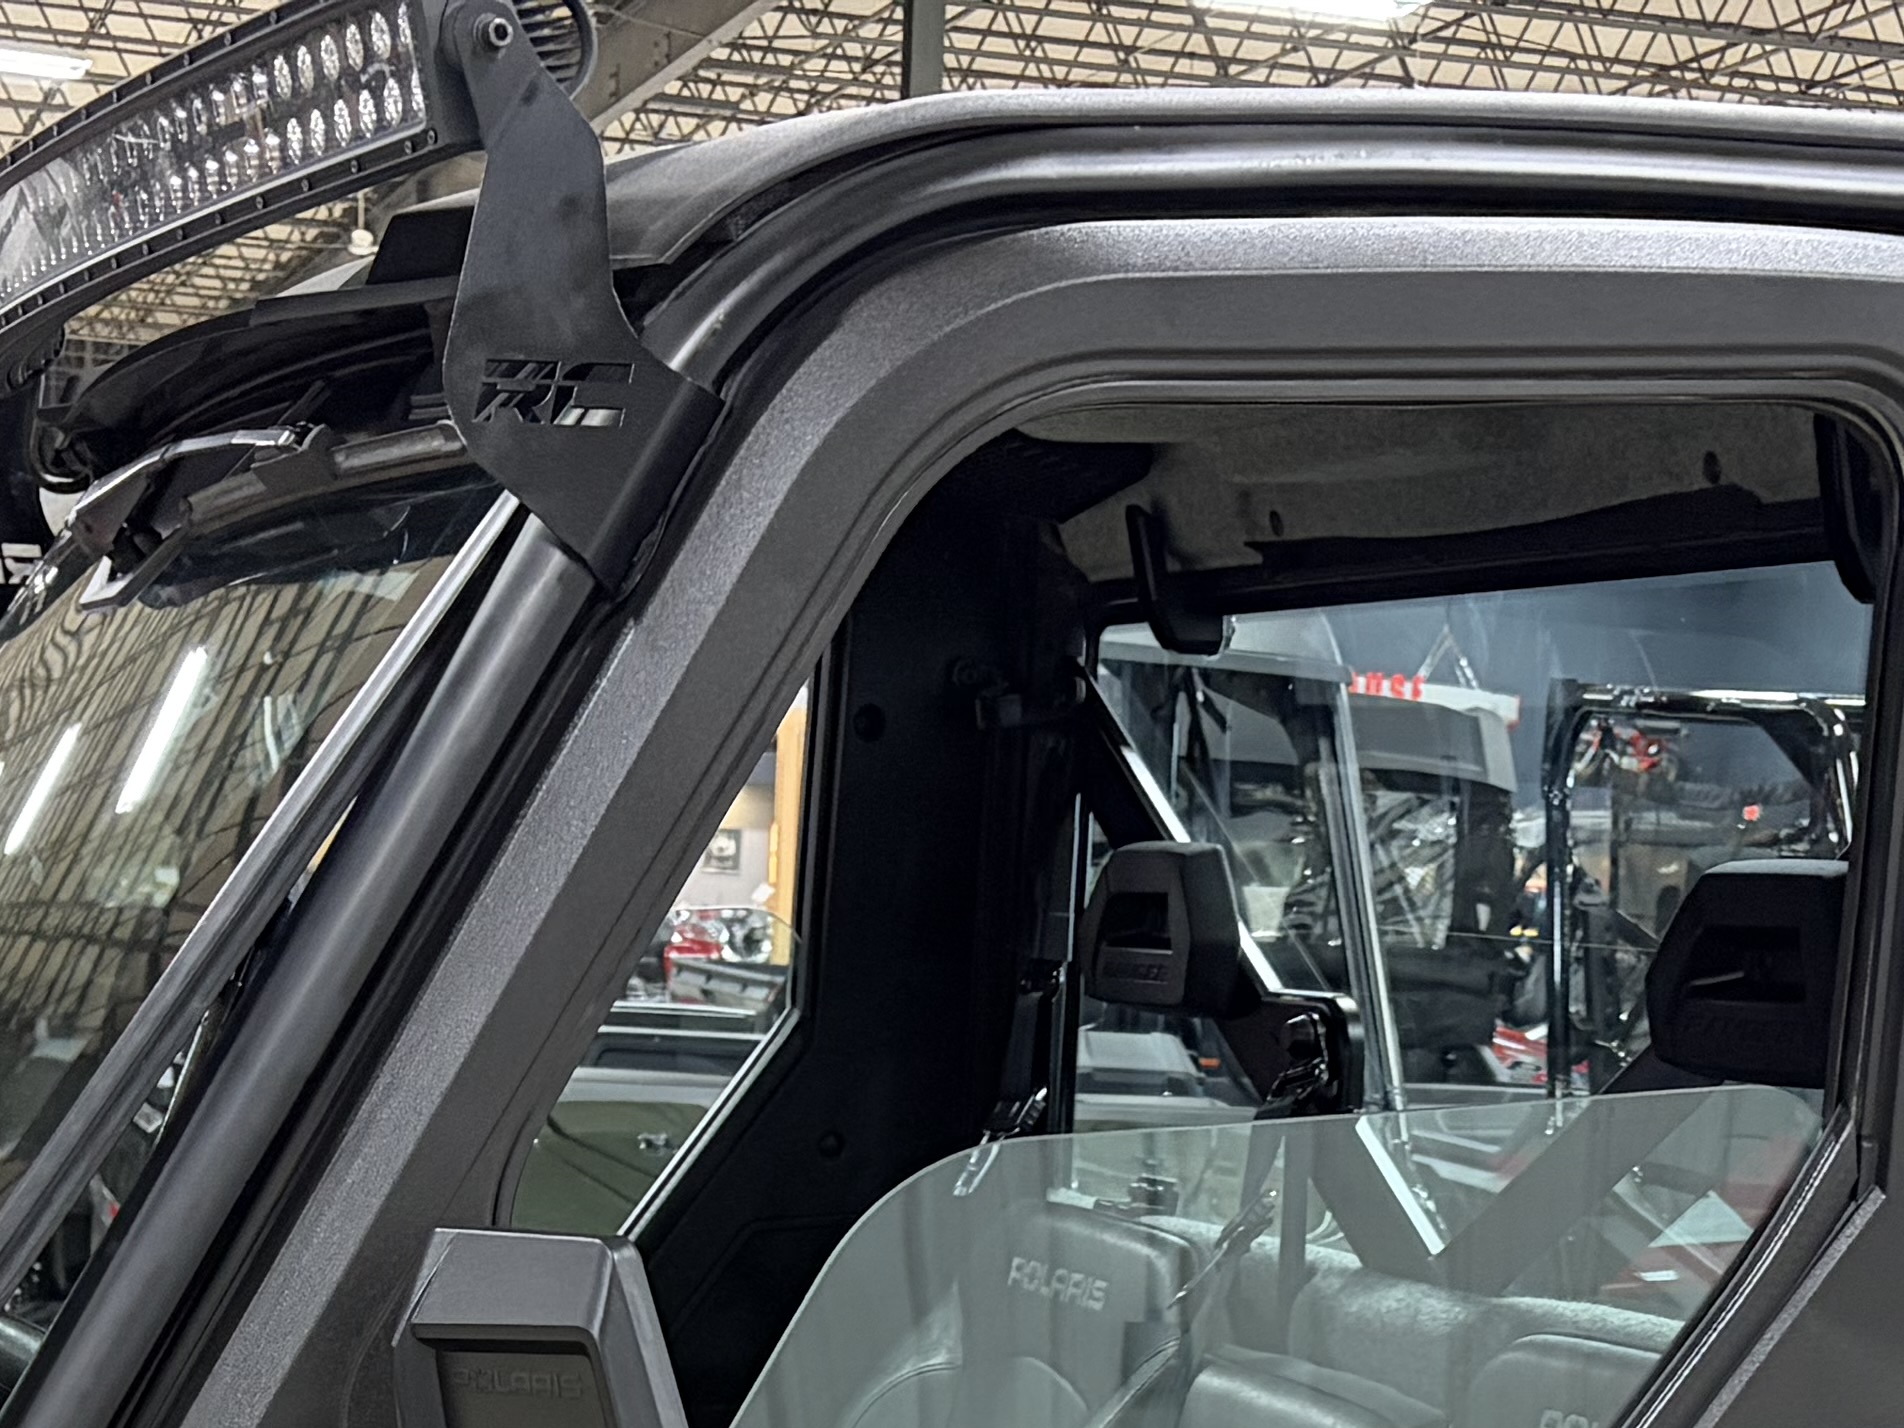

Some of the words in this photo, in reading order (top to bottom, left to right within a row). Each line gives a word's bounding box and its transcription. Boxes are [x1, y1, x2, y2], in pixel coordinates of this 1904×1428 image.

[473, 358, 634, 427] RC
[1007, 1256, 1110, 1312] POLARIS
[453, 1366, 584, 1400] POLARIS
